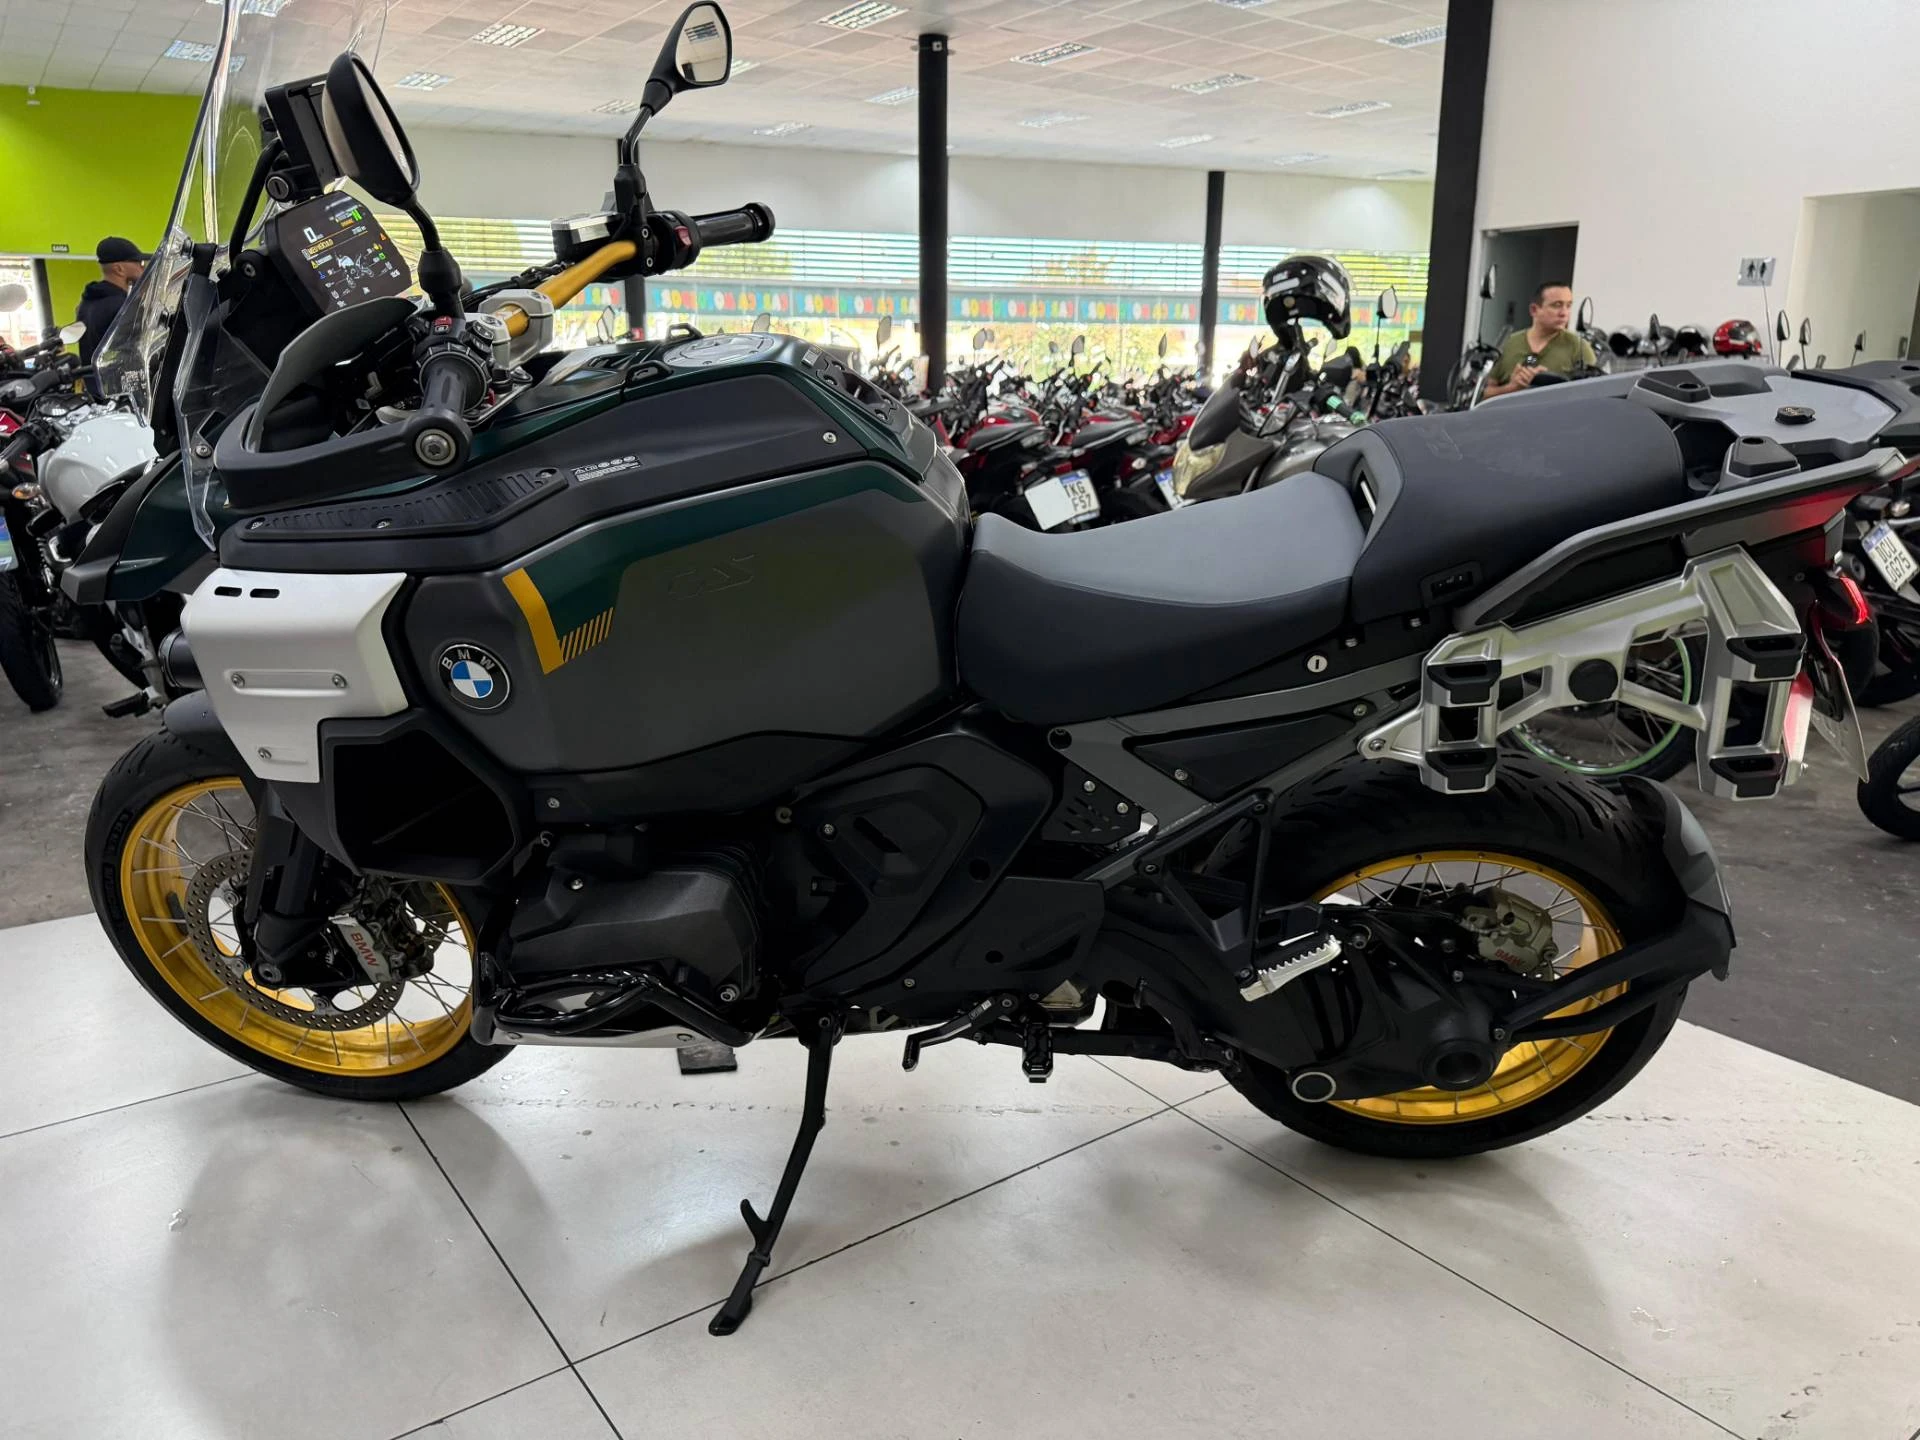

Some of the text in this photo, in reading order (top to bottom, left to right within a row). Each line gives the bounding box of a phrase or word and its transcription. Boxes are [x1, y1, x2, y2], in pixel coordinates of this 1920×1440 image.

[441, 648, 496, 671] BMW
[351, 932, 380, 968] BMW
[1495, 949, 1524, 967] BMW
